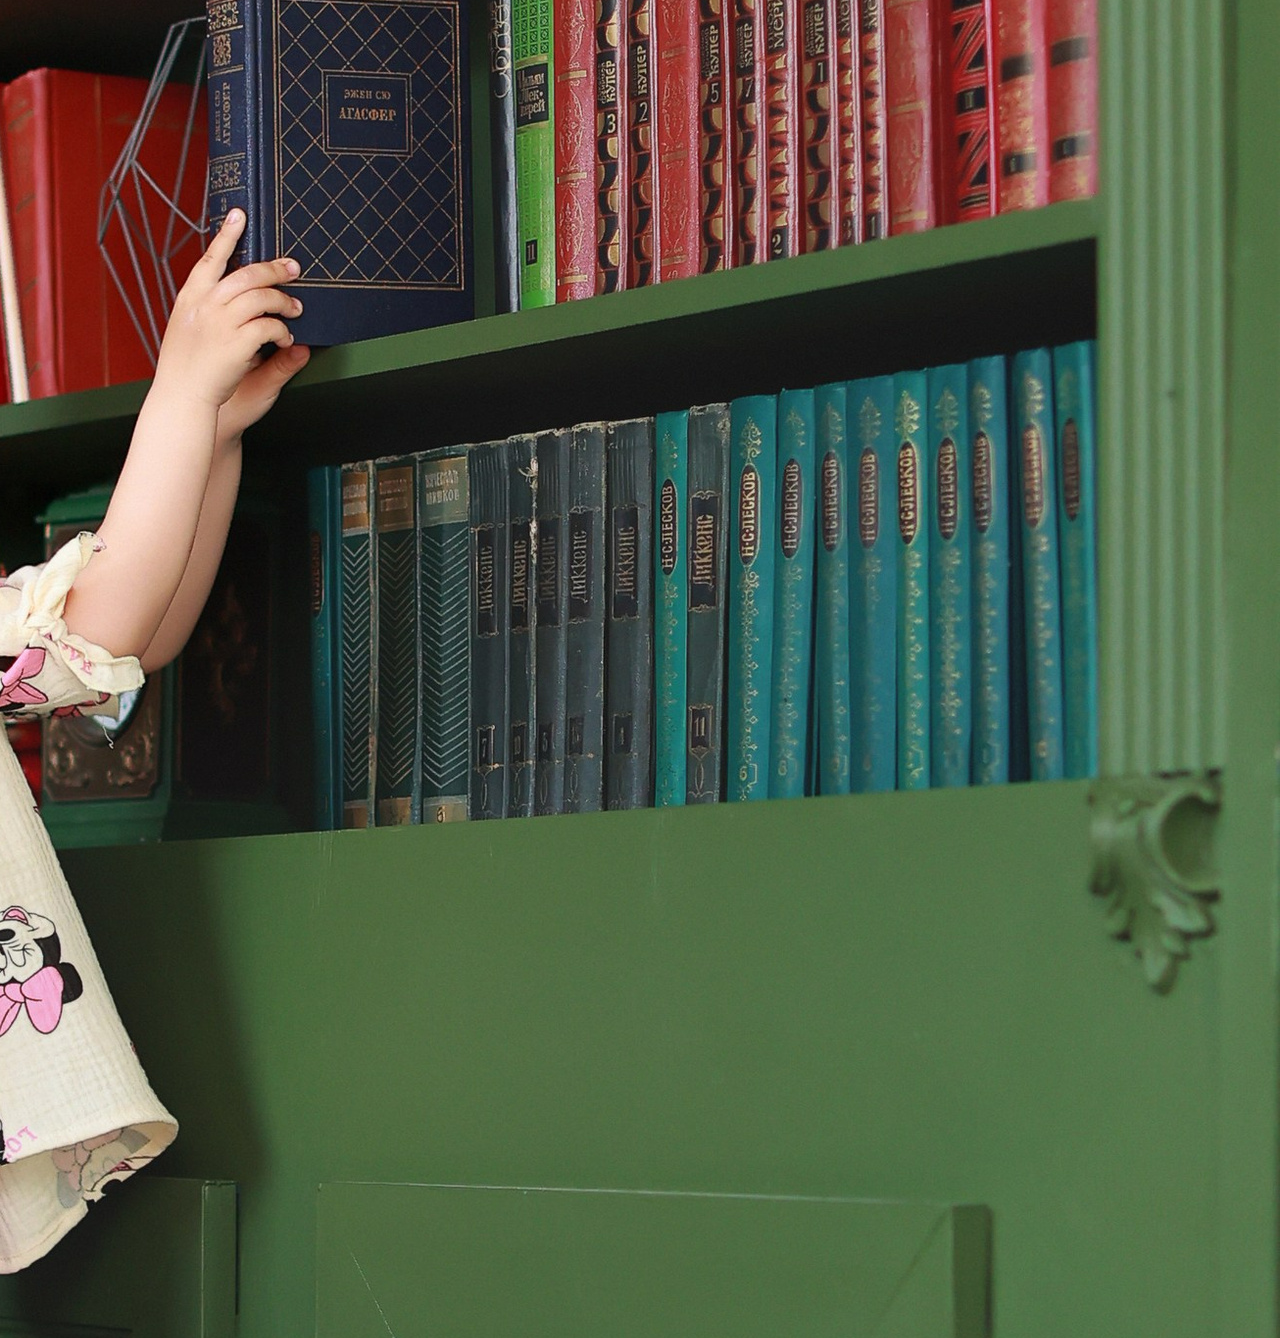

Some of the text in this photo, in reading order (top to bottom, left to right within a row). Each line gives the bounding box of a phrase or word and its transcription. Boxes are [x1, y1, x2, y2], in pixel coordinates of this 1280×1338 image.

[708, 25, 719, 76] КУПЕР
[744, 23, 754, 67] КУПЕР
[814, 3, 825, 55] КУПЕР
[606, 60, 616, 103] КУПЕР
[637, 45, 648, 95] КУПЕР
[745, 76, 753, 98] 7
[818, 62, 824, 83] 1
[222, 82, 231, 146] АГАСФЕР
[344, 88, 391, 100] ЭЖЕН СЮ
[639, 102, 648, 122] 2
[711, 82, 719, 103] 5
[339, 107, 396, 122] АГАСФЕР
[607, 113, 616, 133] 3
[772, 234, 782, 255] 2
[571, 530, 588, 604] Диккенс
[615, 526, 635, 600] Диккенс
[693, 514, 714, 591] Диккенс
[512, 539, 527, 612] Диккенс
[694, 716, 706, 737] 11
